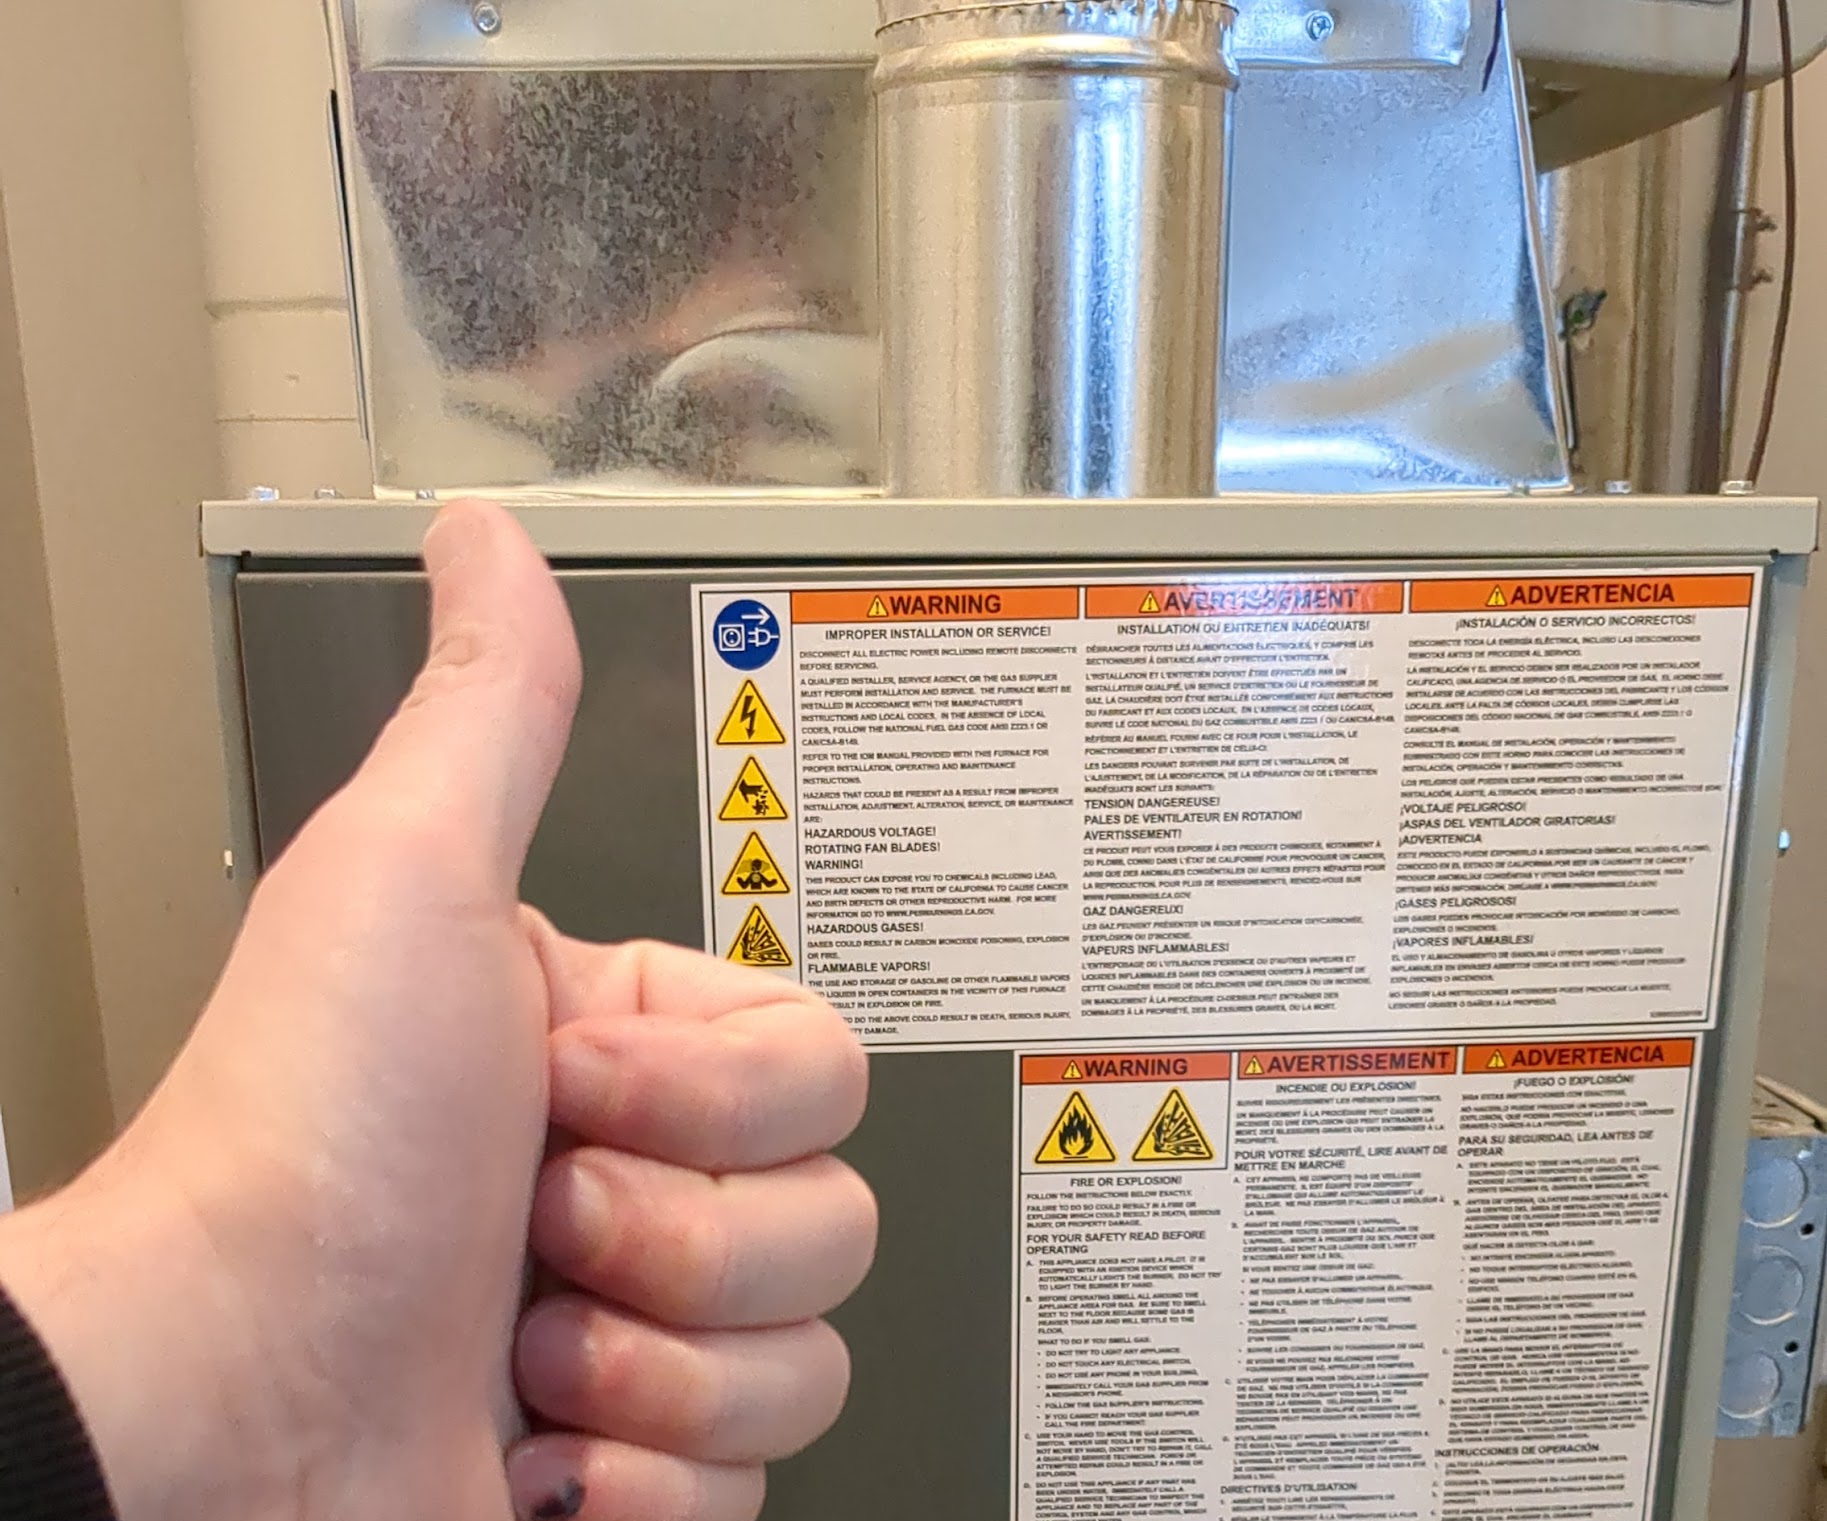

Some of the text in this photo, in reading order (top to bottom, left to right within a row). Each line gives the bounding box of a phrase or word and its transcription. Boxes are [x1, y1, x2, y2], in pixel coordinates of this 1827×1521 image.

[1163, 588, 1359, 612] AVERTISSEMENT
[1510, 583, 1674, 604] ADVERTENCIA
[890, 594, 1000, 614] WARNING
[1117, 619, 1369, 634] INSTALLATION OU ENTRETIEN INADÉQUATS!
[1456, 615, 1695, 630] ¡INSTALACIÓN O SERVICIO INCORRECTOS!
[825, 626, 1050, 639] IMPROPER INSTALLATION OR SERVICE!
[1084, 796, 1219, 808] TENSION DANGEREUSE!
[1400, 801, 1526, 815] ¡VOLTAJE PELIGROSO!
[1084, 810, 1301, 824] PALES DE VENTILATEUR EN ROTATION!
[1399, 815, 1615, 831] ¡ASPAS DEL VENTILADOR GIRATORIAS!
[804, 826, 935, 838] HAZARDOUS VOLTAGE!
[1084, 829, 1181, 840] AVERTISSEMENT!
[1398, 834, 1481, 846] ¡ADVERTENCIA
[805, 842, 939, 854] ROTATING FAN BLADES!
[805, 859, 862, 869] WARNING!
[1395, 896, 1516, 910] ¡GASES PELIGROSOS!
[1083, 905, 1183, 916] GAZ DANGEREUX!
[807, 922, 923, 934] HAZARDOUS GASES!
[1393, 935, 1533, 948] ¡VAPORES INFLAMABLES!
[1082, 942, 1228, 955] VAPEURS INFLAMMABLES!
[808, 961, 929, 973] FLAMMABLE VAPORS!
[1267, 1051, 1449, 1072] AVERTISSEMENT
[1511, 1045, 1663, 1066] ADVERTENCIA
[1084, 1058, 1187, 1076] WARNING
[1070, 1176, 1181, 1186] FIRE OR EXPLOSION!
